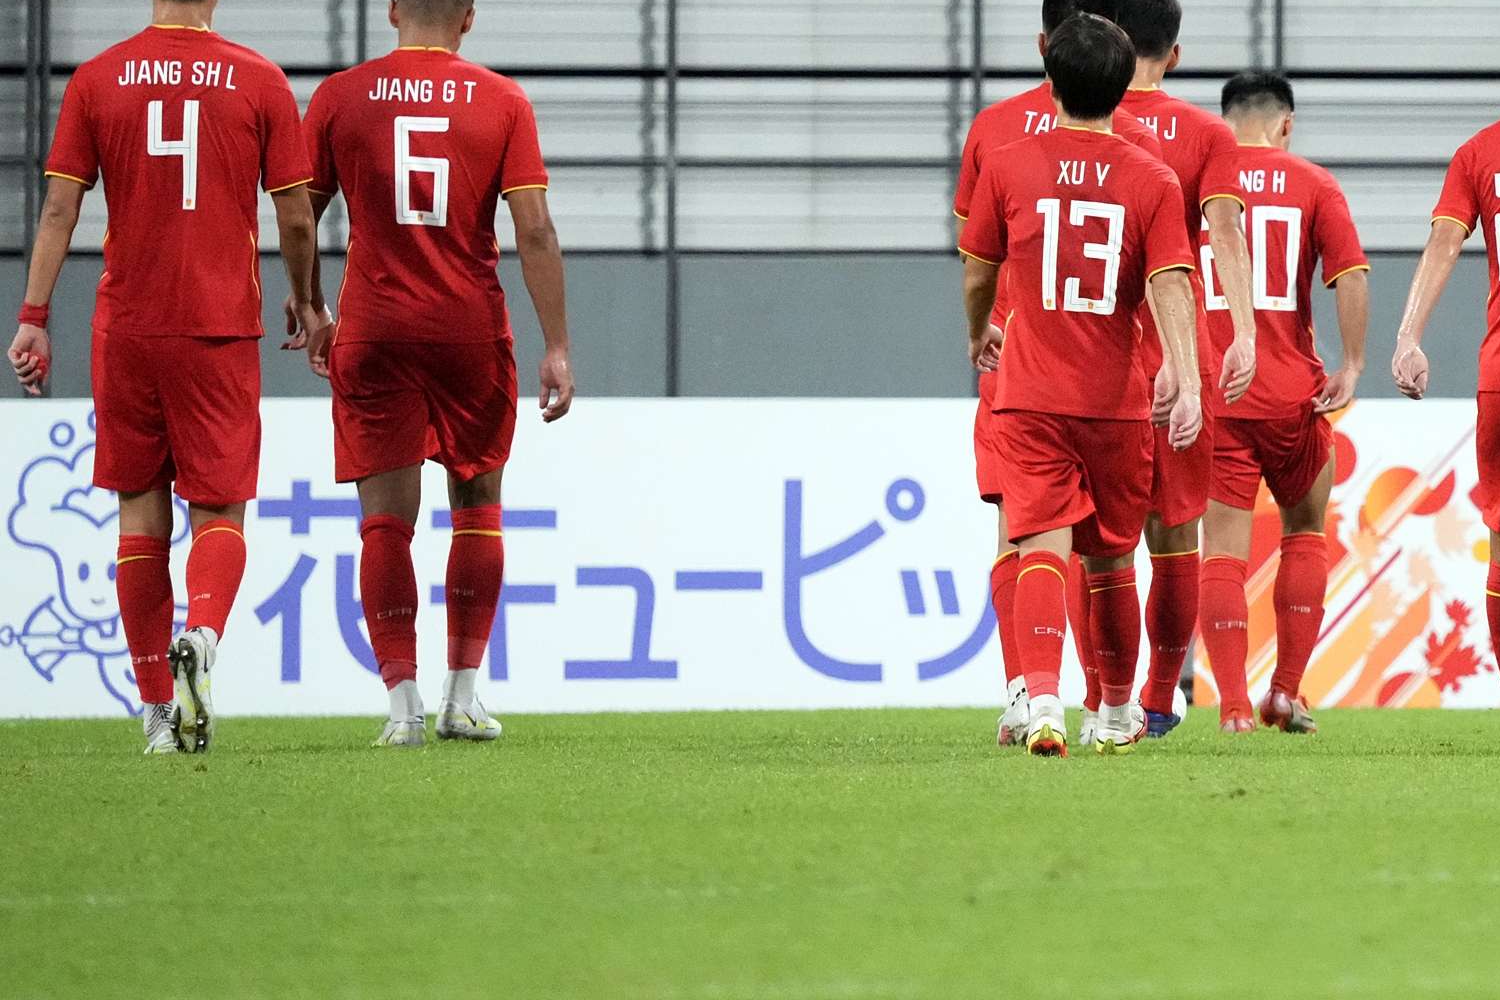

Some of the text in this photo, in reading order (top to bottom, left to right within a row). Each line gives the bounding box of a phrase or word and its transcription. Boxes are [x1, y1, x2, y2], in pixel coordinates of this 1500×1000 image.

[119, 60, 235, 89] JIANG SH L
[369, 78, 476, 103] JIANG G T
[1025, 111, 1057, 134] TA
[1137, 117, 1176, 139] H J
[148, 100, 199, 209] 4
[394, 116, 449, 226] 6
[1057, 161, 1110, 186] XU Y
[1273, 170, 1285, 193] H
[1037, 198, 1125, 315] 13
